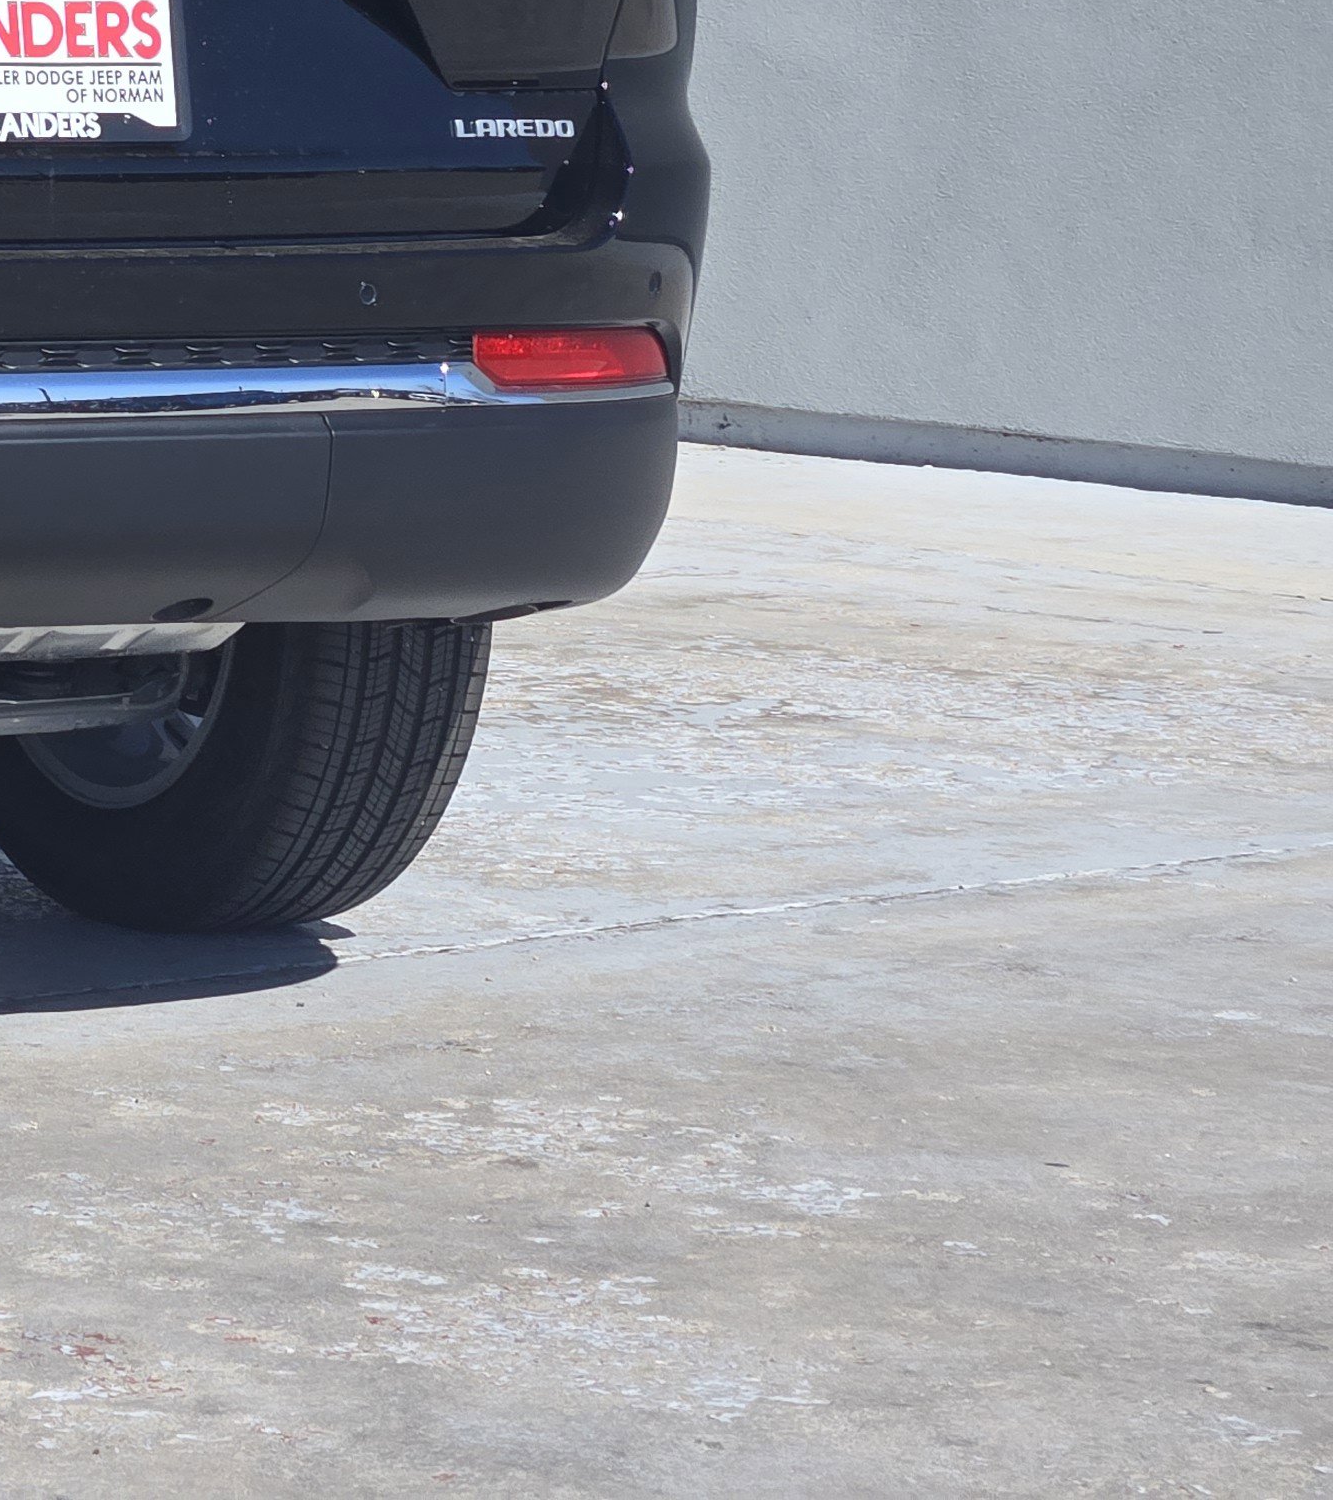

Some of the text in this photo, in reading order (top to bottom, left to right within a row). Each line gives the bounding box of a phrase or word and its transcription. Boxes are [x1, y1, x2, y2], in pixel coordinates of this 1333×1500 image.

[25, 70, 85, 86] DODGE
[89, 70, 123, 86] JEEP
[128, 70, 163, 86] RAM
[66, 88, 164, 104] OF NORMAN
[453, 118, 575, 138] LAREDO
